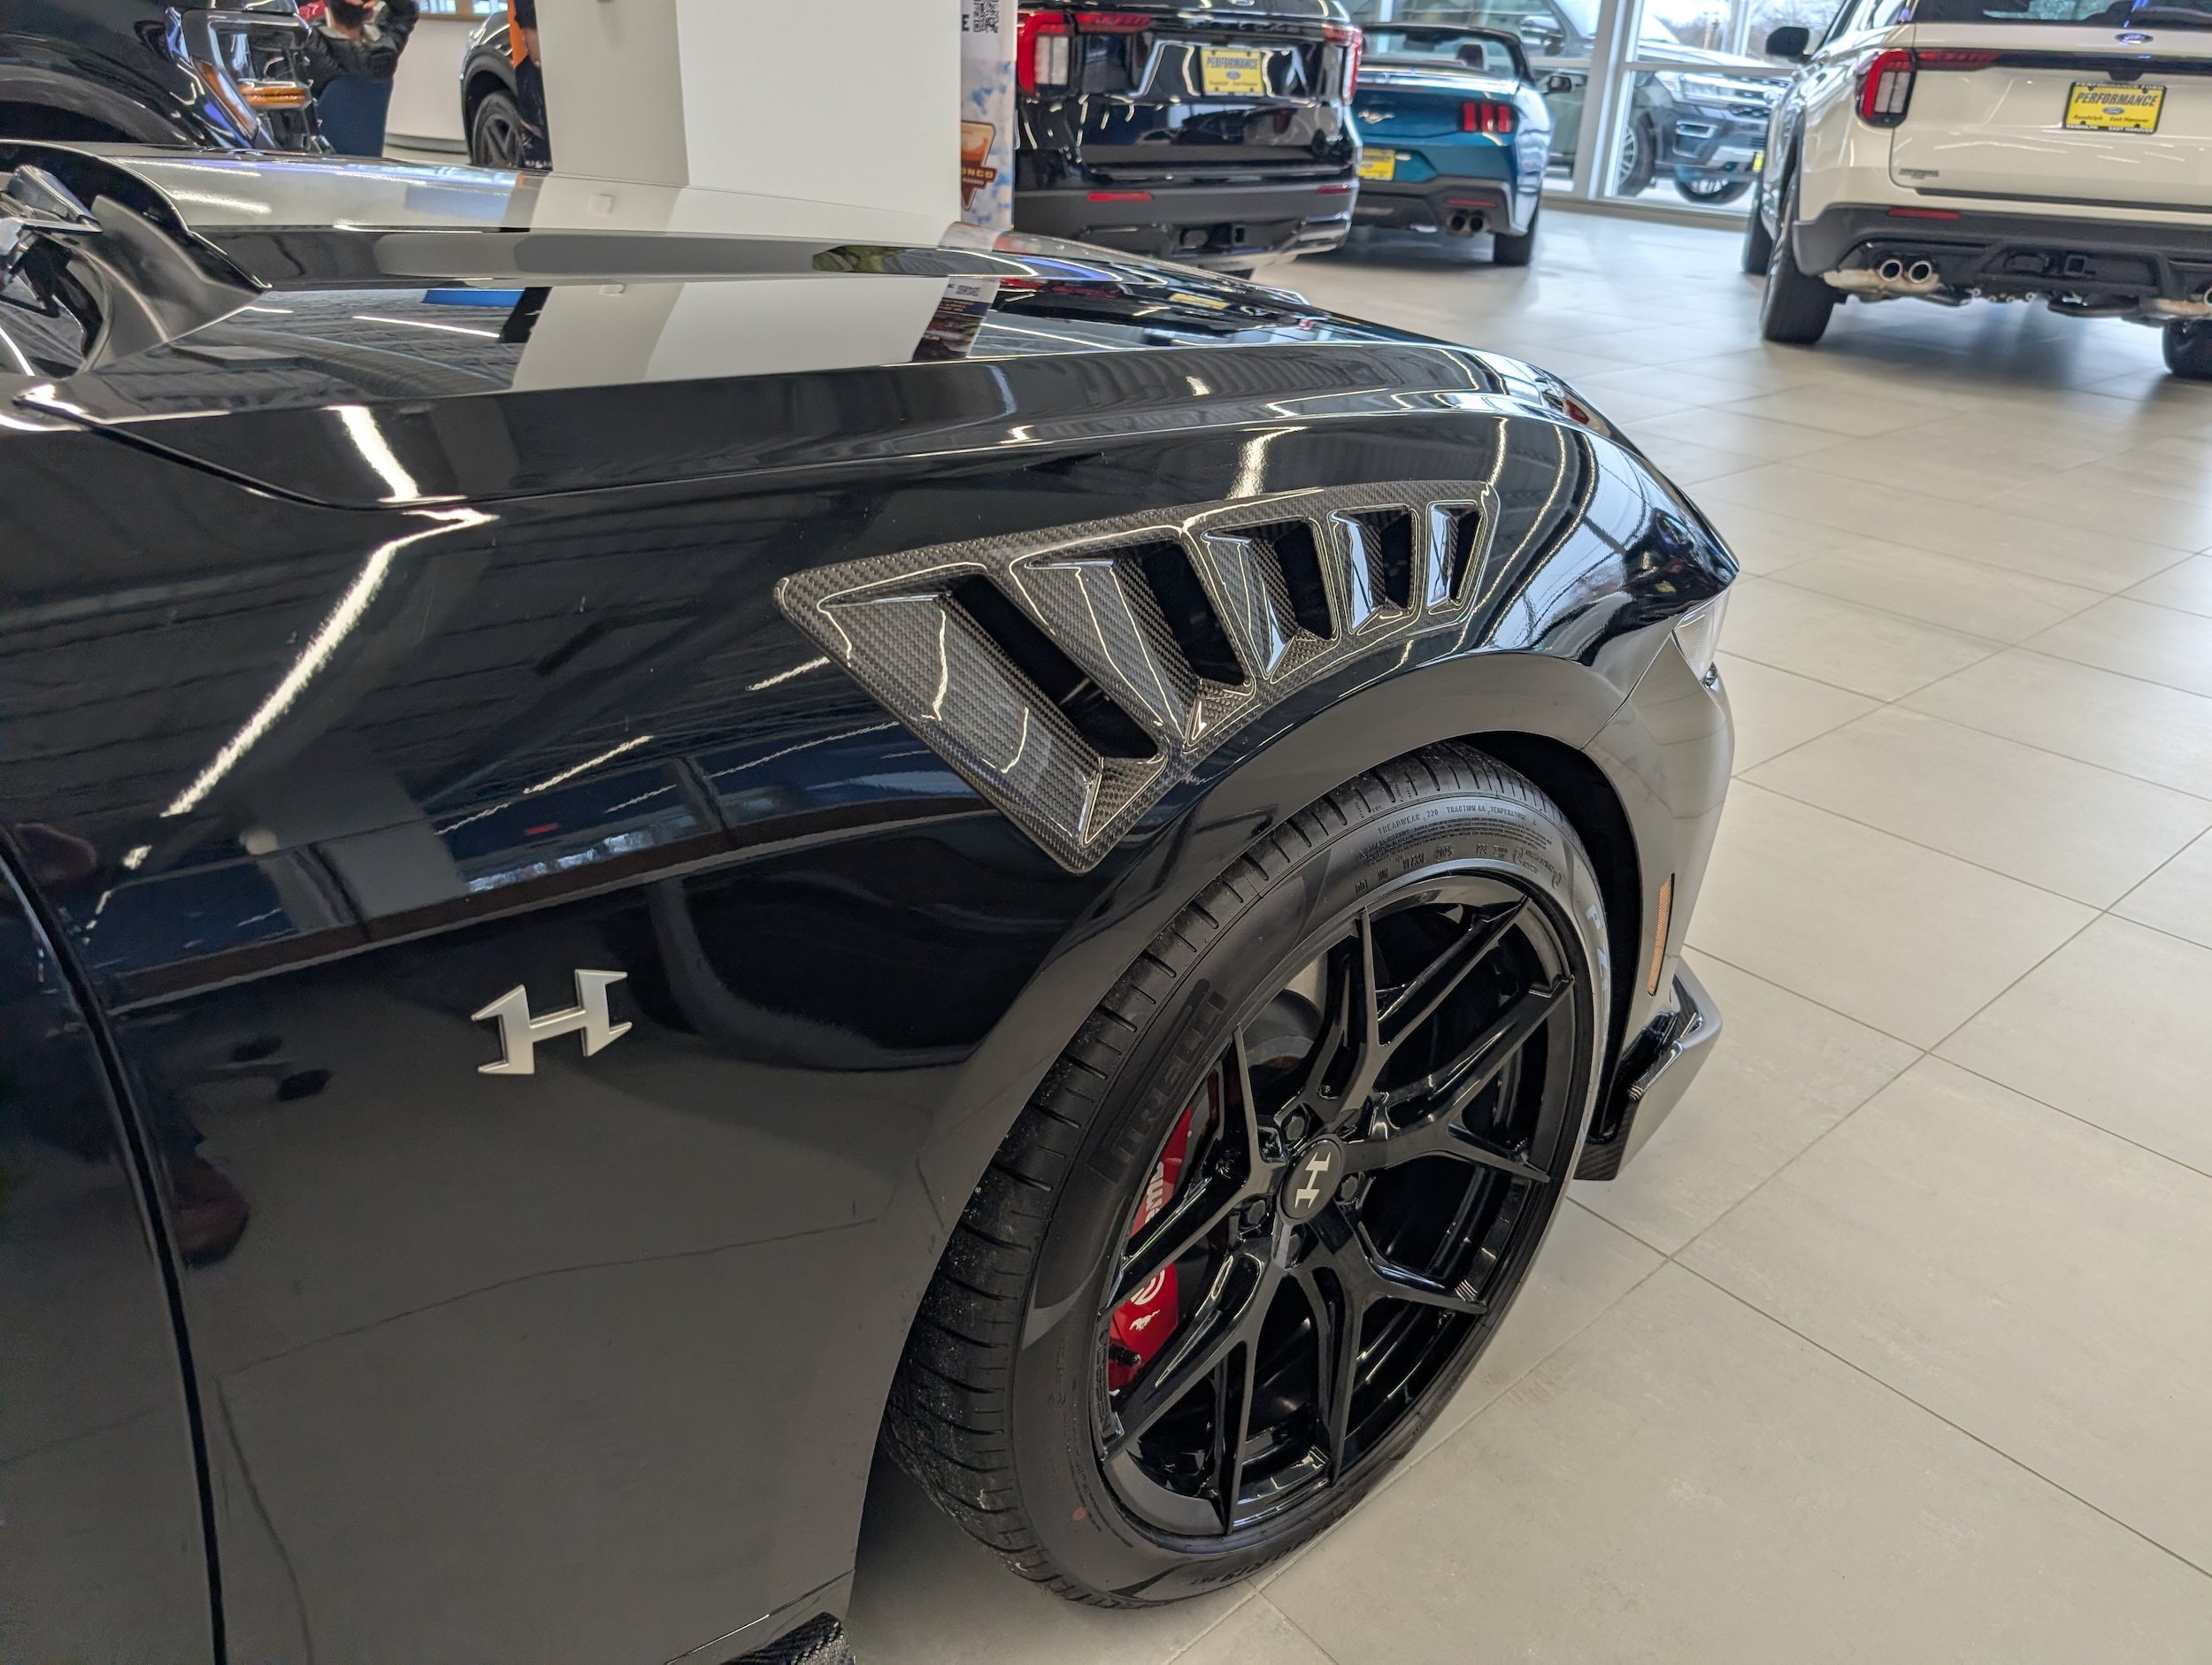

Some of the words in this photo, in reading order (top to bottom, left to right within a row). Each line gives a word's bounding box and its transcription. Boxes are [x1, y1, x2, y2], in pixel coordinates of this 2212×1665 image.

[1207, 57, 1260, 70] PERFORMANCE
[2074, 92, 2159, 107] PERFORMANCE
[1377, 814, 1420, 834] TREADWEAR
[1447, 804, 1476, 813] TRACTION
[1490, 806, 1526, 821] TEMPERATURE
